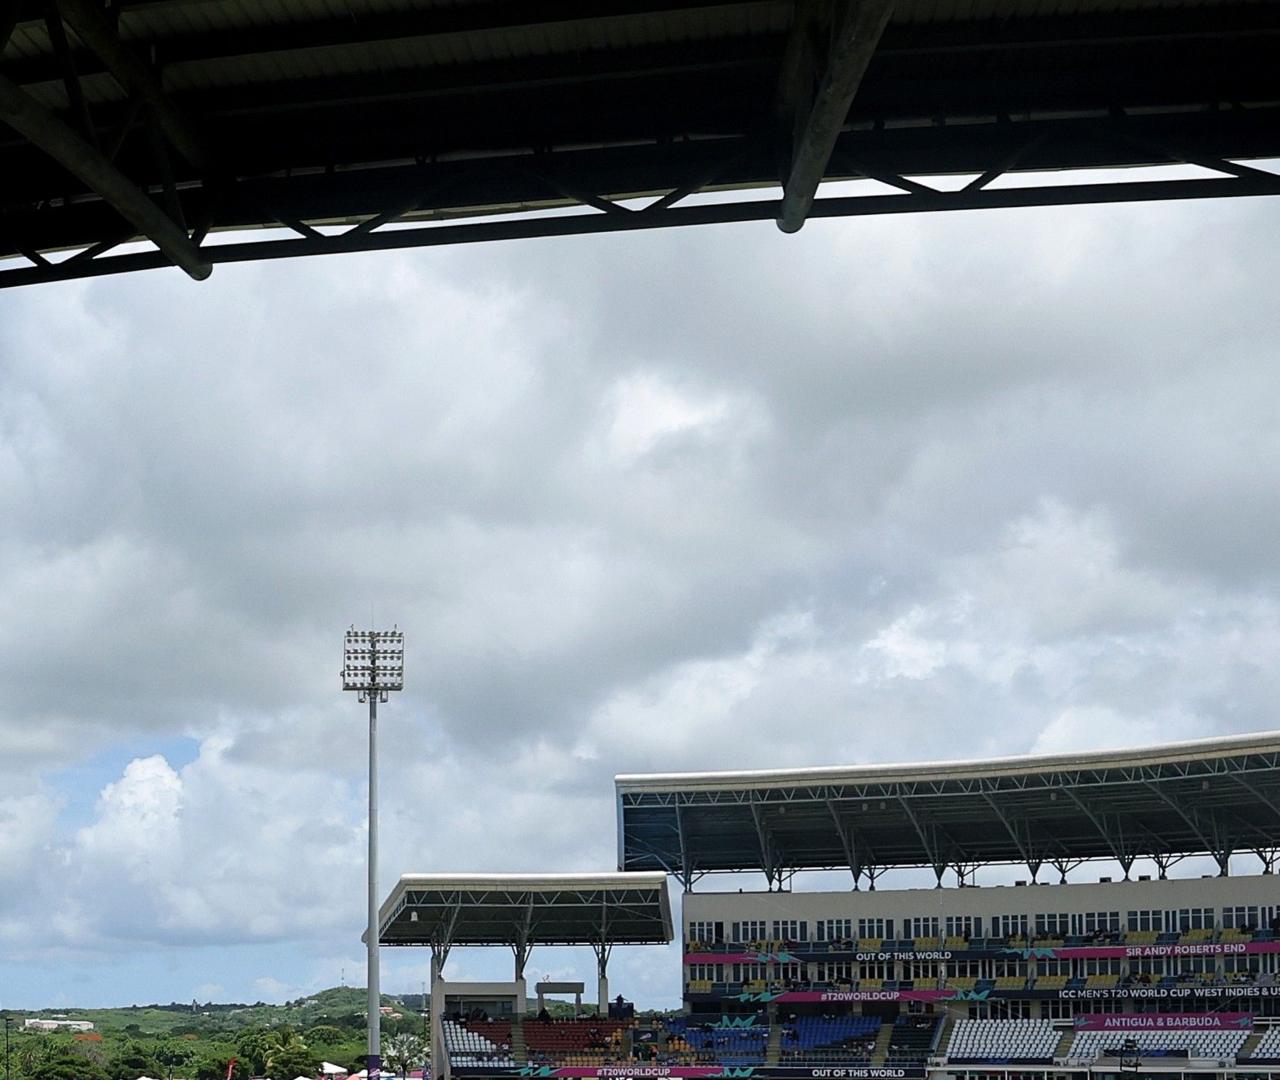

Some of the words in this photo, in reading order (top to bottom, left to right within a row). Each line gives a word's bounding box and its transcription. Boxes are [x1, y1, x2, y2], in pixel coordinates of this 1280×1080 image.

[1126, 947, 1142, 956] SIR
[1144, 946, 1172, 956] ANDY
[1174, 945, 1222, 955] ROBERTS
[1224, 944, 1246, 954] END
[856, 953, 876, 961] OUT
[878, 952, 891, 960] OF
[893, 952, 914, 960] THIS
[916, 951, 952, 960] WORLD
[821, 992, 900, 1001] #T20WORLDCUP
[1058, 990, 1077, 999] ICC
[1078, 989, 1109, 998] MEN'S
[1110, 988, 1129, 998] T20
[1130, 988, 1167, 998] WORLD
[1170, 988, 1191, 998] CUP
[1194, 988, 1223, 997] WEST
[1225, 987, 1259, 996] INDIES
[1261, 987, 1270, 996] &
[1104, 1017, 1155, 1027] ANTIGUA
[1156, 1017, 1164, 1026] &
[1166, 1017, 1221, 1026] BARBUDA
[596, 1068, 670, 1077] #T20WORLDCUP
[812, 1068, 831, 1078] OUT
[833, 1068, 847, 1078] OF
[848, 1068, 869, 1078] THIS
[870, 1068, 905, 1078] WORLD
